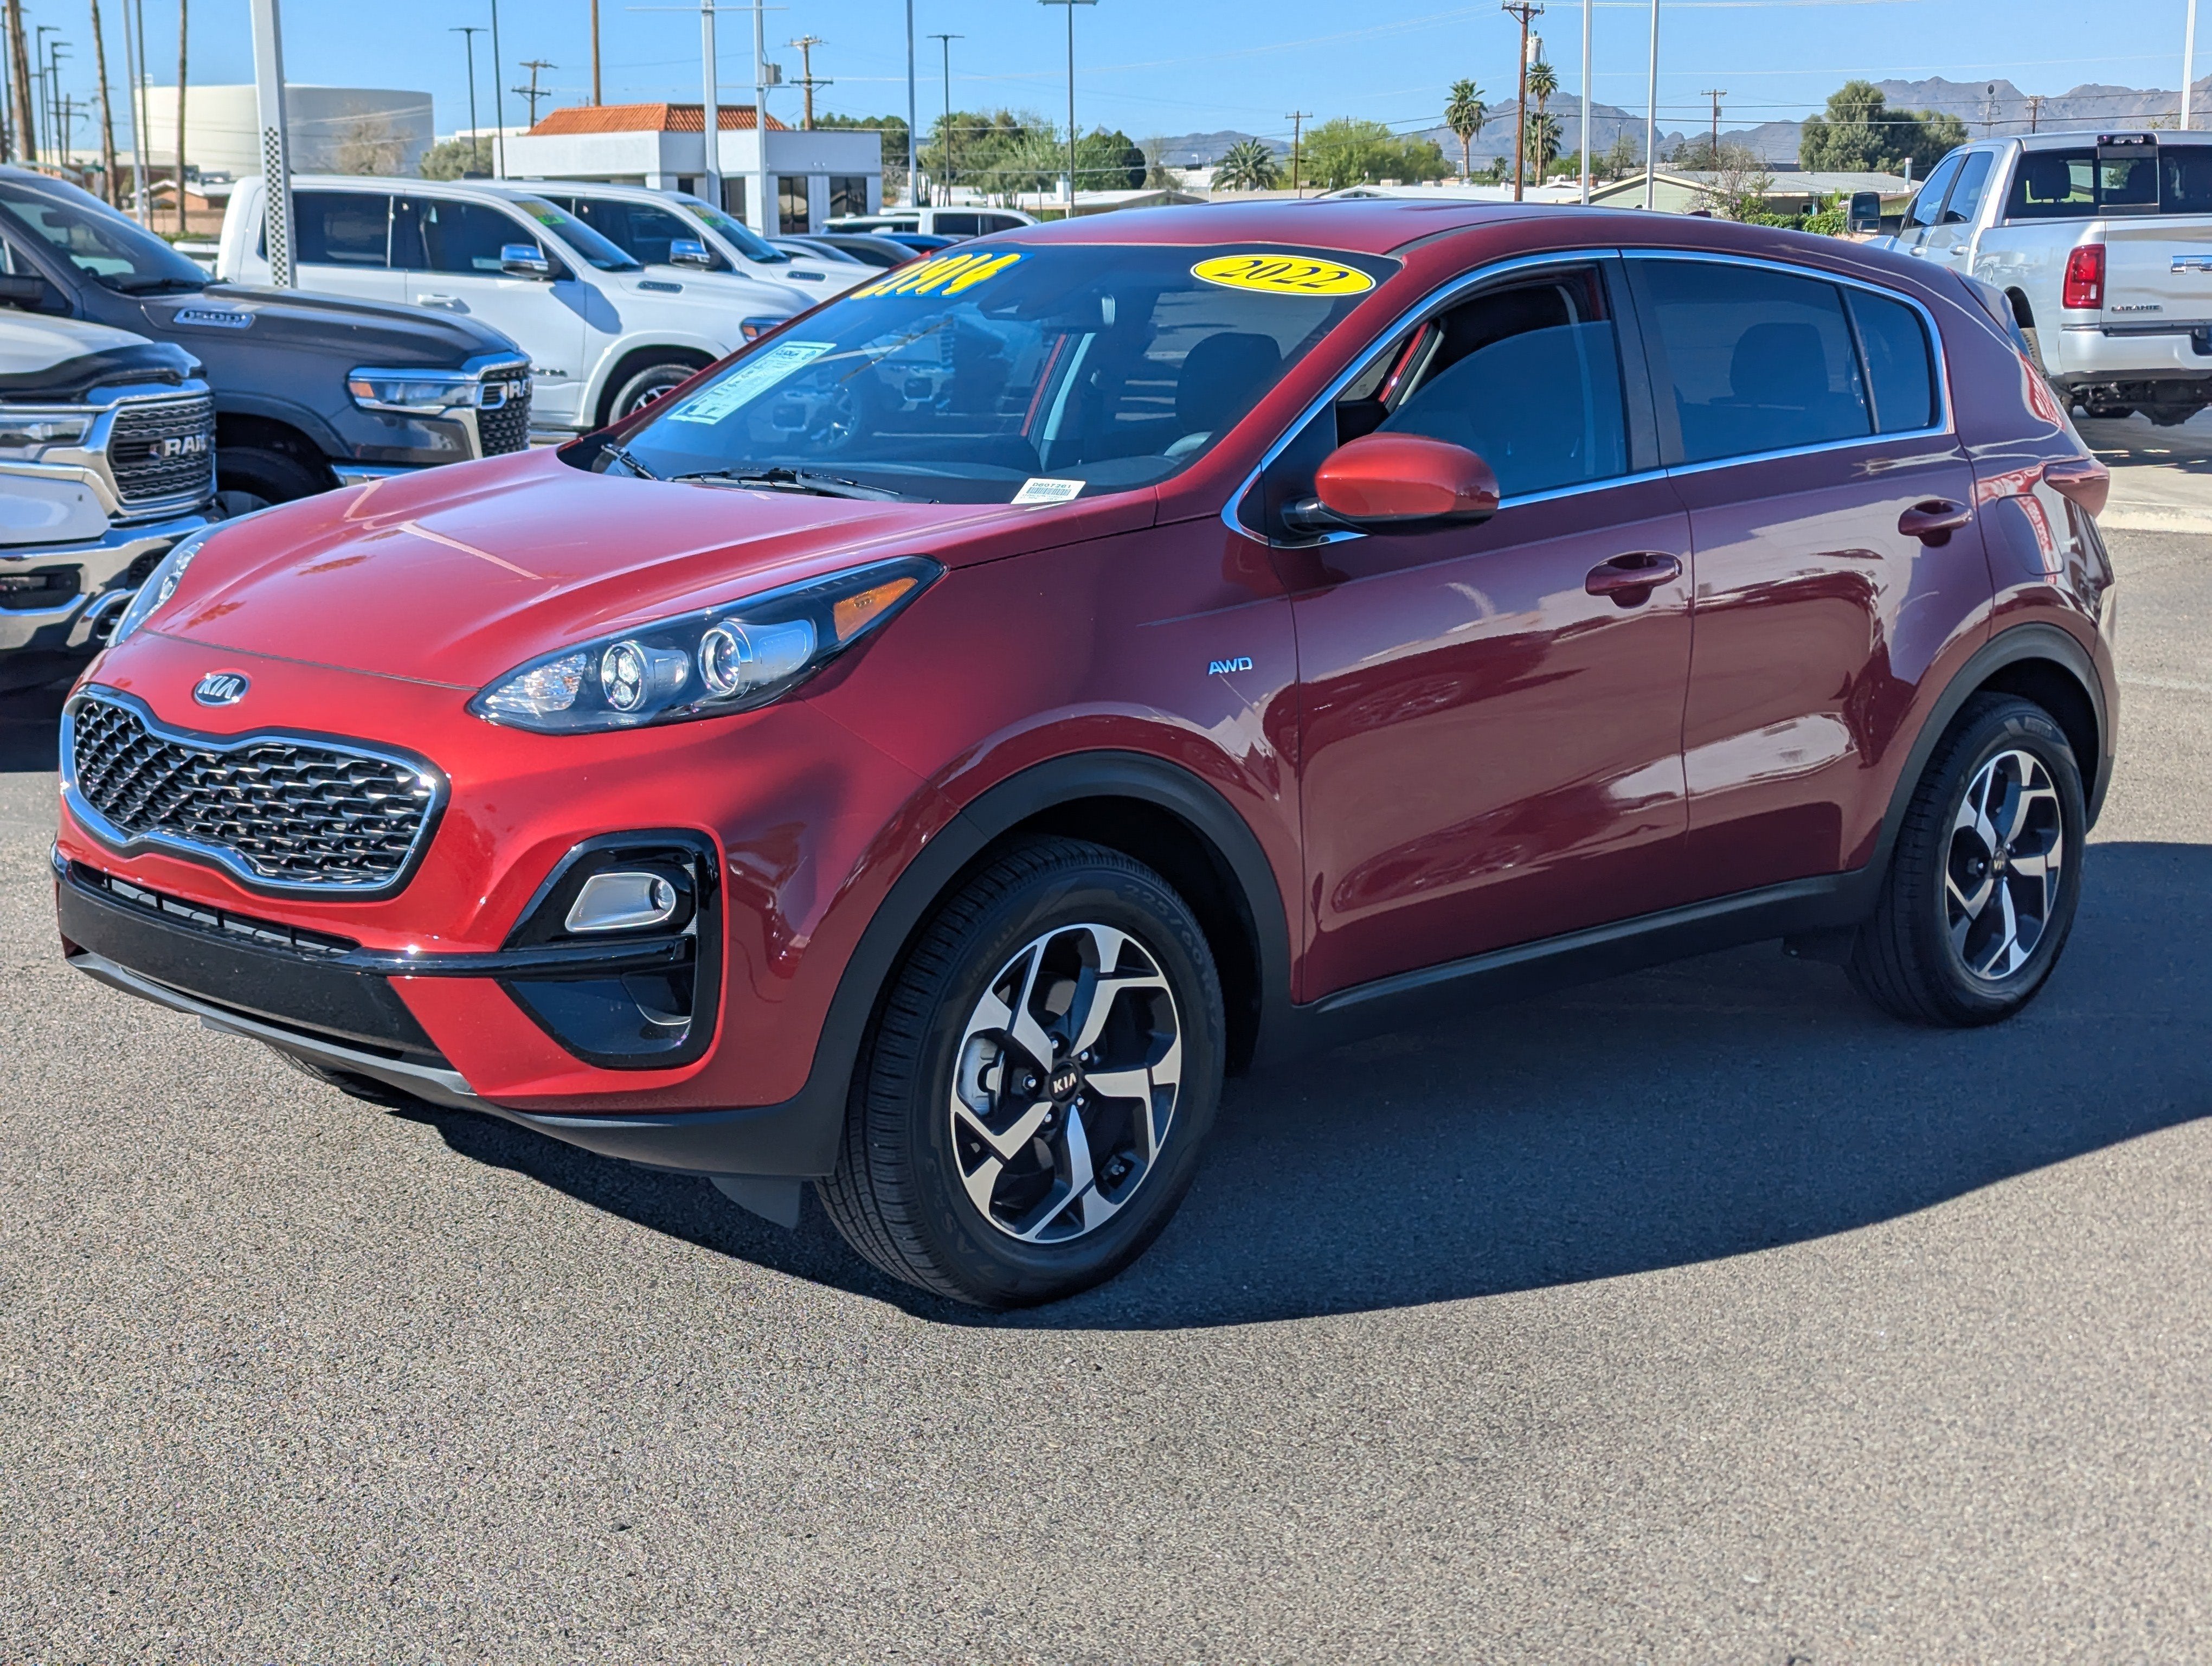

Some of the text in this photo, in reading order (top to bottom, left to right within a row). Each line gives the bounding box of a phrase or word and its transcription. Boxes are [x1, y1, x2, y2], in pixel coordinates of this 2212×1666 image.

[1212, 260, 1350, 289] 2022
[1208, 657, 1253, 675] AWD
[198, 675, 240, 699] KIA
[1053, 1072, 1077, 1093] KIA
